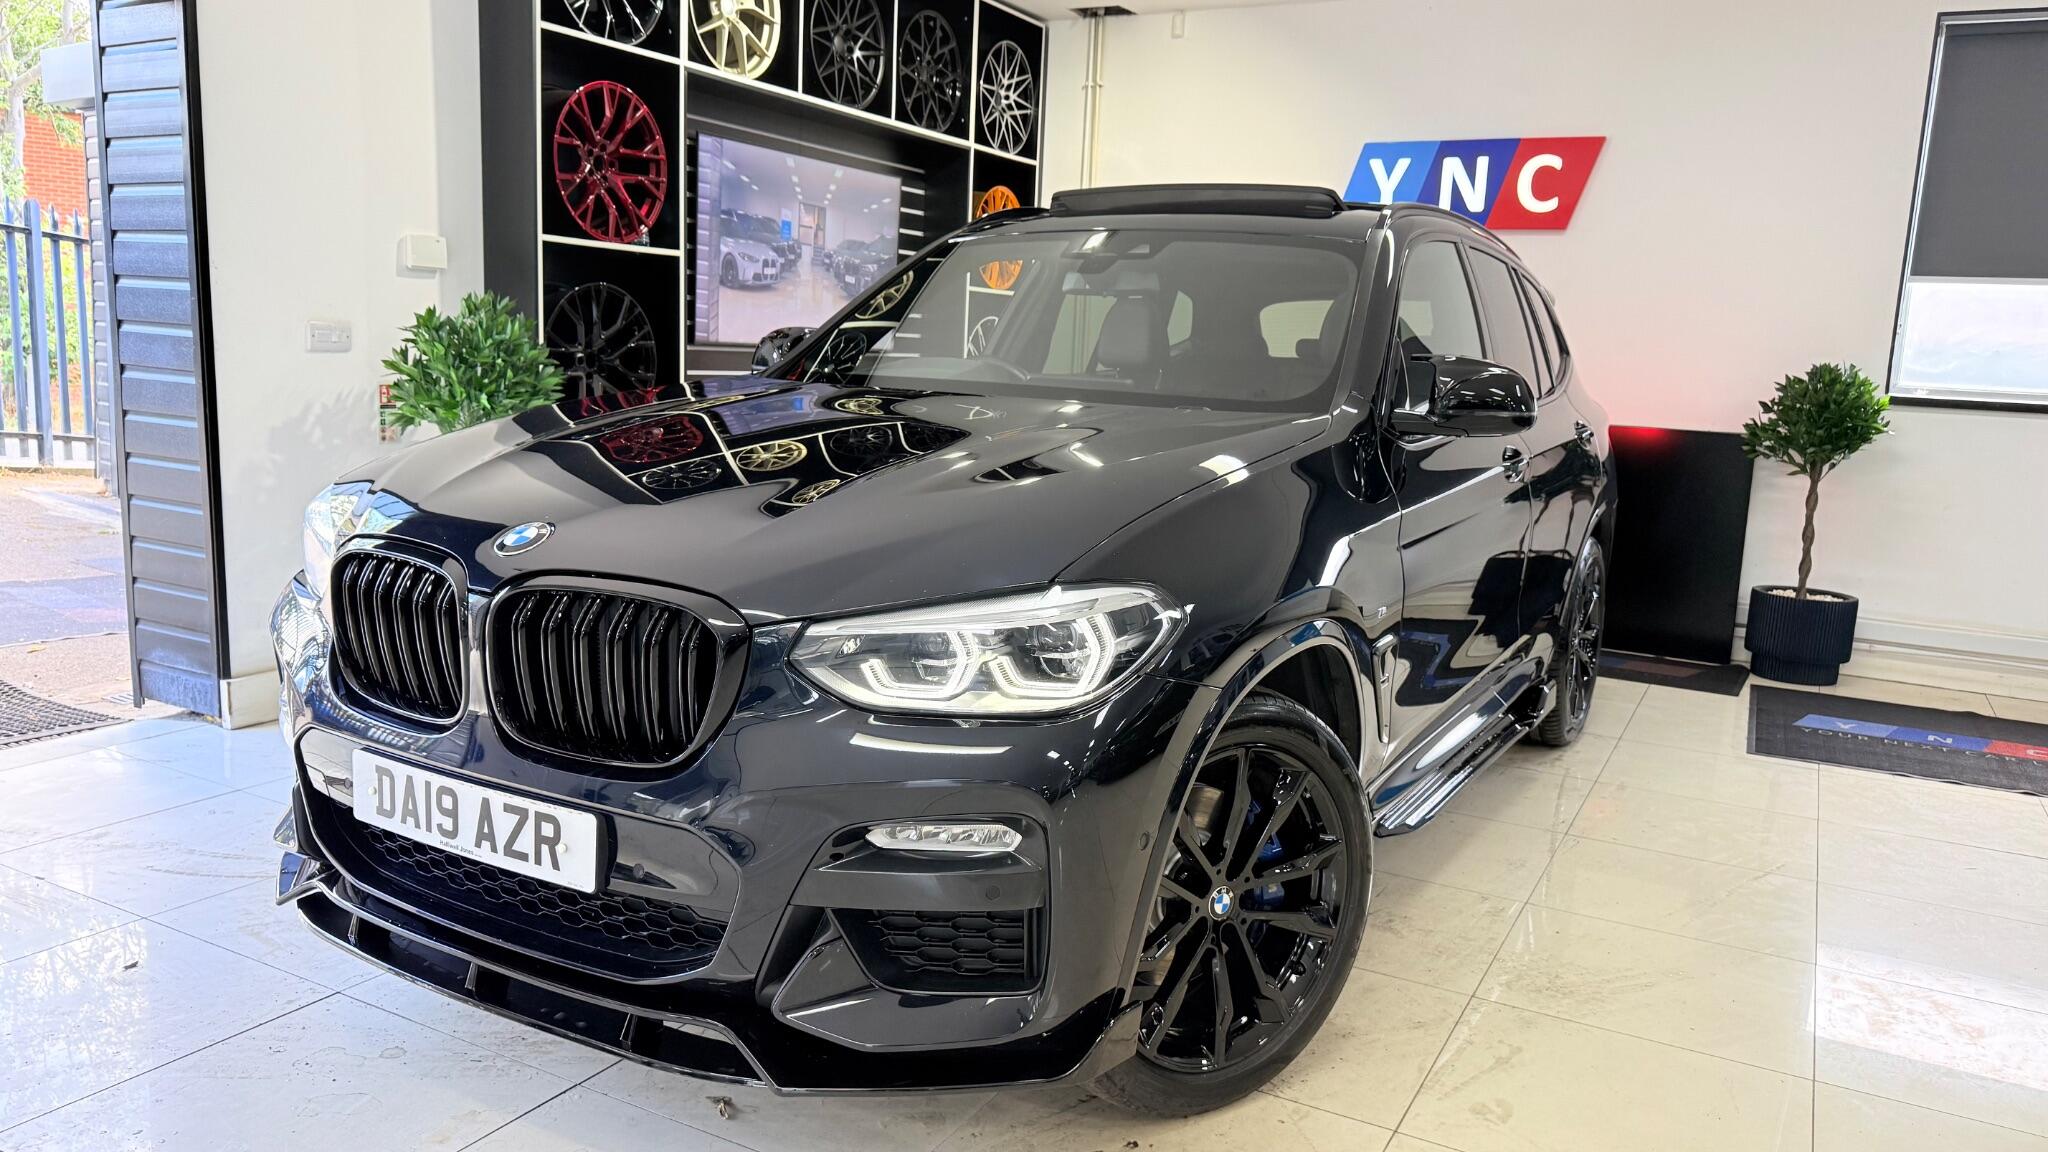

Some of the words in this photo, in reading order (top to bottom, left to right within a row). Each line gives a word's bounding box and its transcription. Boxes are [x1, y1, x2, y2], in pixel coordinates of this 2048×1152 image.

[1369, 153, 1563, 213] YNC
[1801, 728, 1868, 740] YOUR
[1884, 739, 1950, 752] NEXT
[375, 764, 459, 840] DA19
[474, 797, 562, 872] AZR
